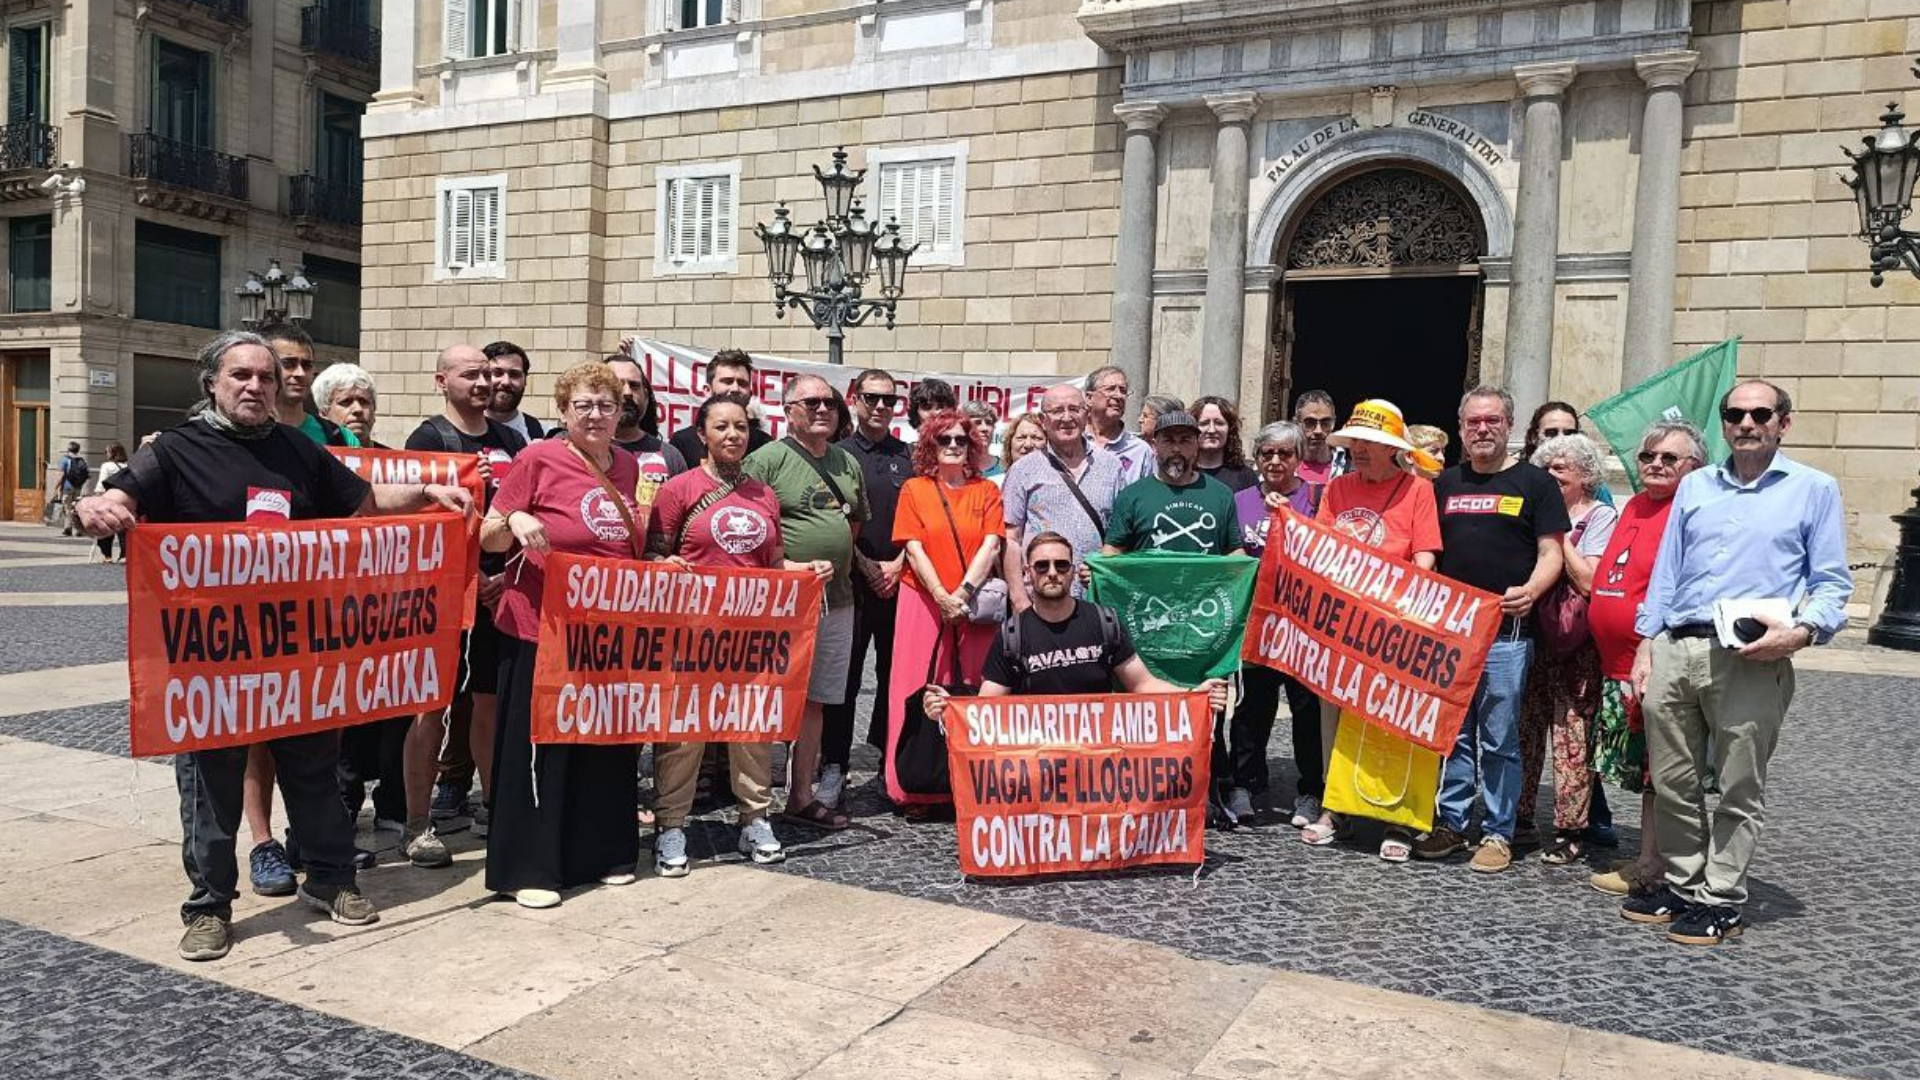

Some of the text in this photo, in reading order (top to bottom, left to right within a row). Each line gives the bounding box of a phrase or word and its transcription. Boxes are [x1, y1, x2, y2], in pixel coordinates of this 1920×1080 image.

[1267, 111, 1503, 182] PALAU DE LA GENERALITAT
[371, 457, 421, 485] AMB
[160, 523, 444, 590] SOLIDARITAT AMB LA
[1283, 516, 1404, 602] SOLIDARITAT
[1395, 575, 1452, 625] AMB
[1444, 592, 1481, 637] LA
[567, 563, 799, 617] SOLIDARITAT AMB LA
[161, 585, 437, 663] VAGA DE LLOGUERS
[565, 623, 791, 675] VAGA DE LLOGUERS
[1273, 565, 1314, 624] VAGA
[1314, 592, 1346, 638] DE
[1341, 603, 1461, 689] LLOGUERS
[164, 647, 439, 743] CONTRA LA CAIXA
[556, 682, 783, 735] CONTRA LA CAIXA
[1258, 613, 1332, 690] CONTRA
[1332, 655, 1364, 707] LA
[1365, 673, 1441, 742] CAIXA
[966, 700, 1193, 746] SOLIDARITAT AMB LA
[968, 755, 1193, 805] VAGA DE LLOGUERS
[971, 808, 1188, 868] CONTRA LA CAIXA
